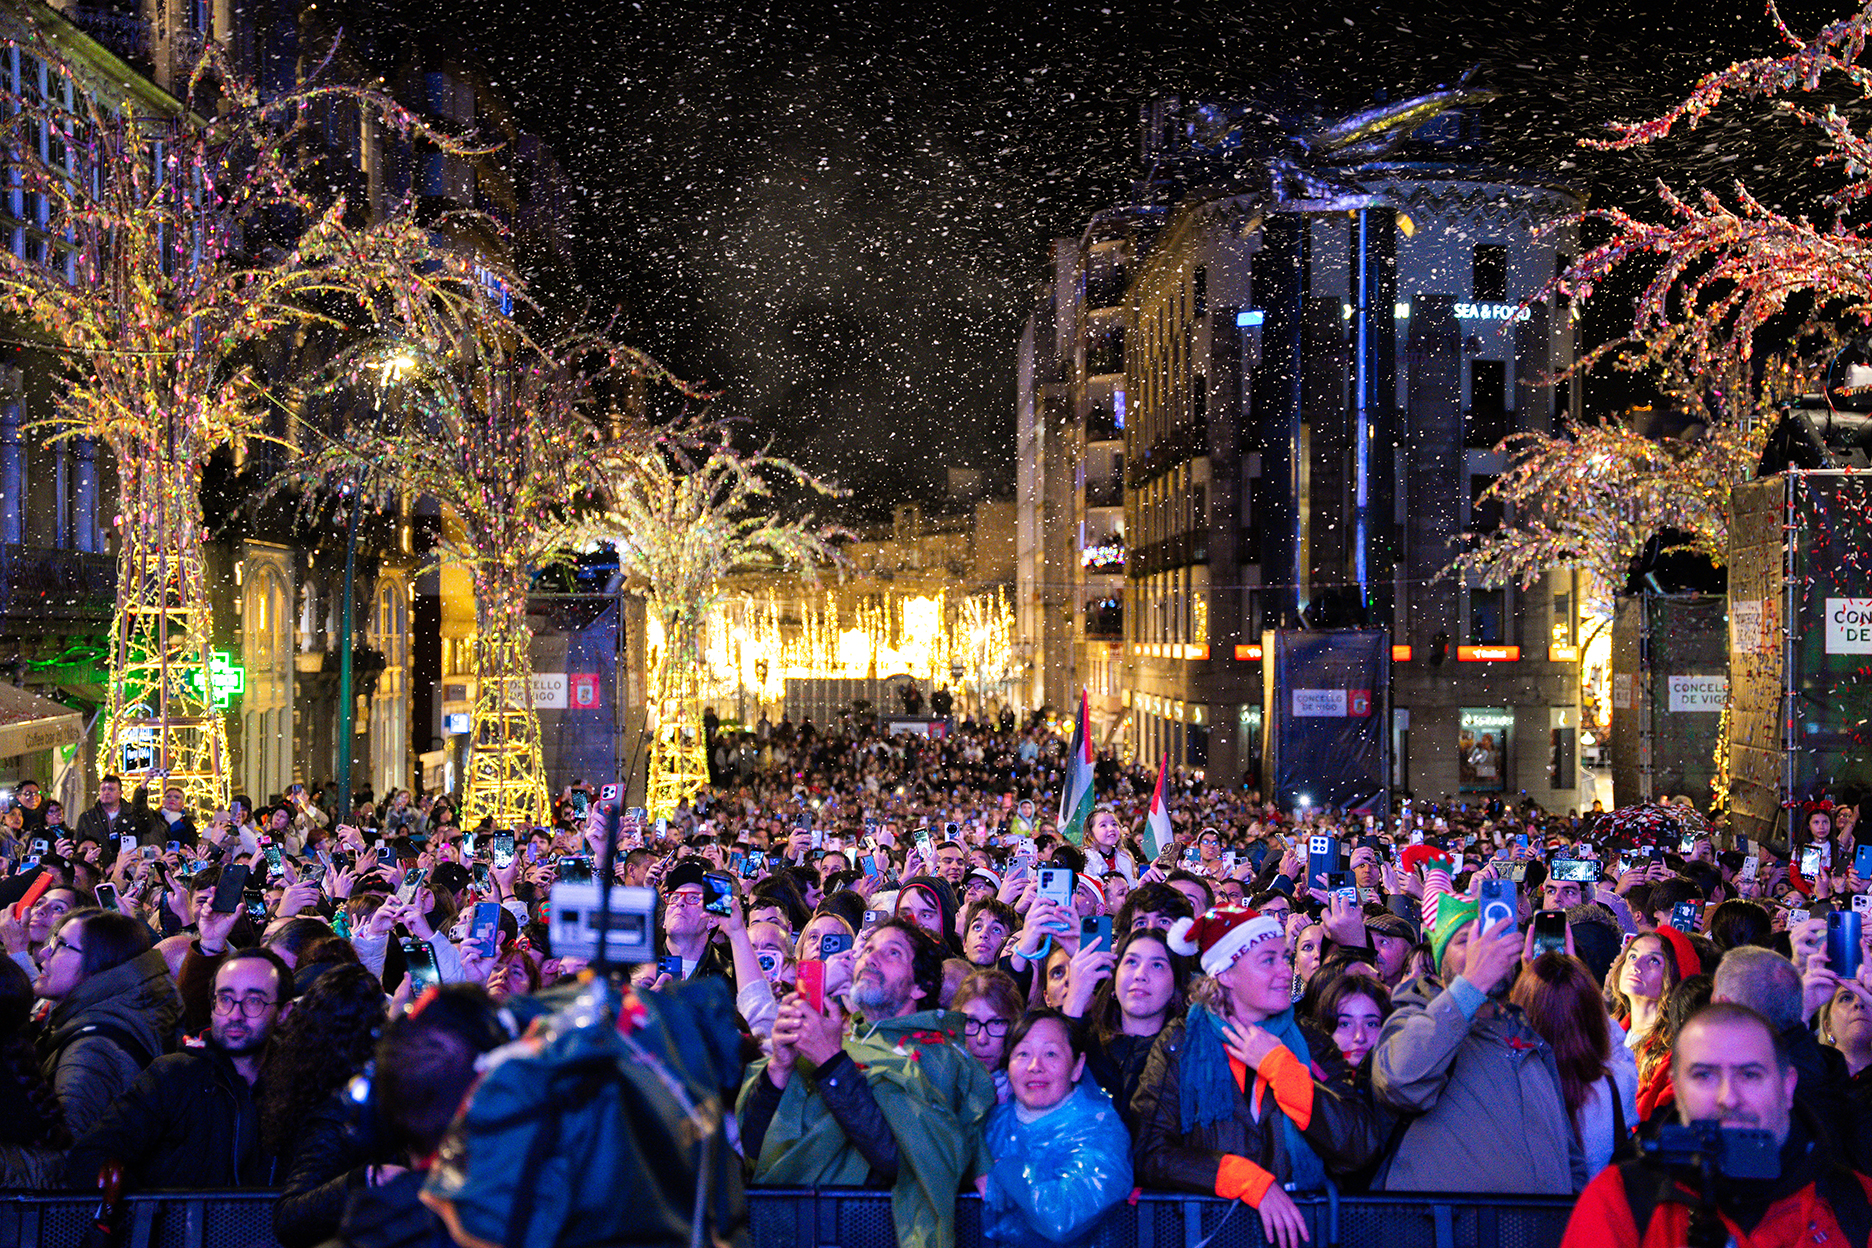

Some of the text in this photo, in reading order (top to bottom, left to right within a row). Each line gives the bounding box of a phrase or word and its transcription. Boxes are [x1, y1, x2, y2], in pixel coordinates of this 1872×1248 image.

[1454, 303, 1479, 319] SEA
[1480, 304, 1491, 319] &
[1847, 628, 1871, 641] DE
[535, 692, 555, 701] IGO
[1681, 694, 1697, 704] DE
